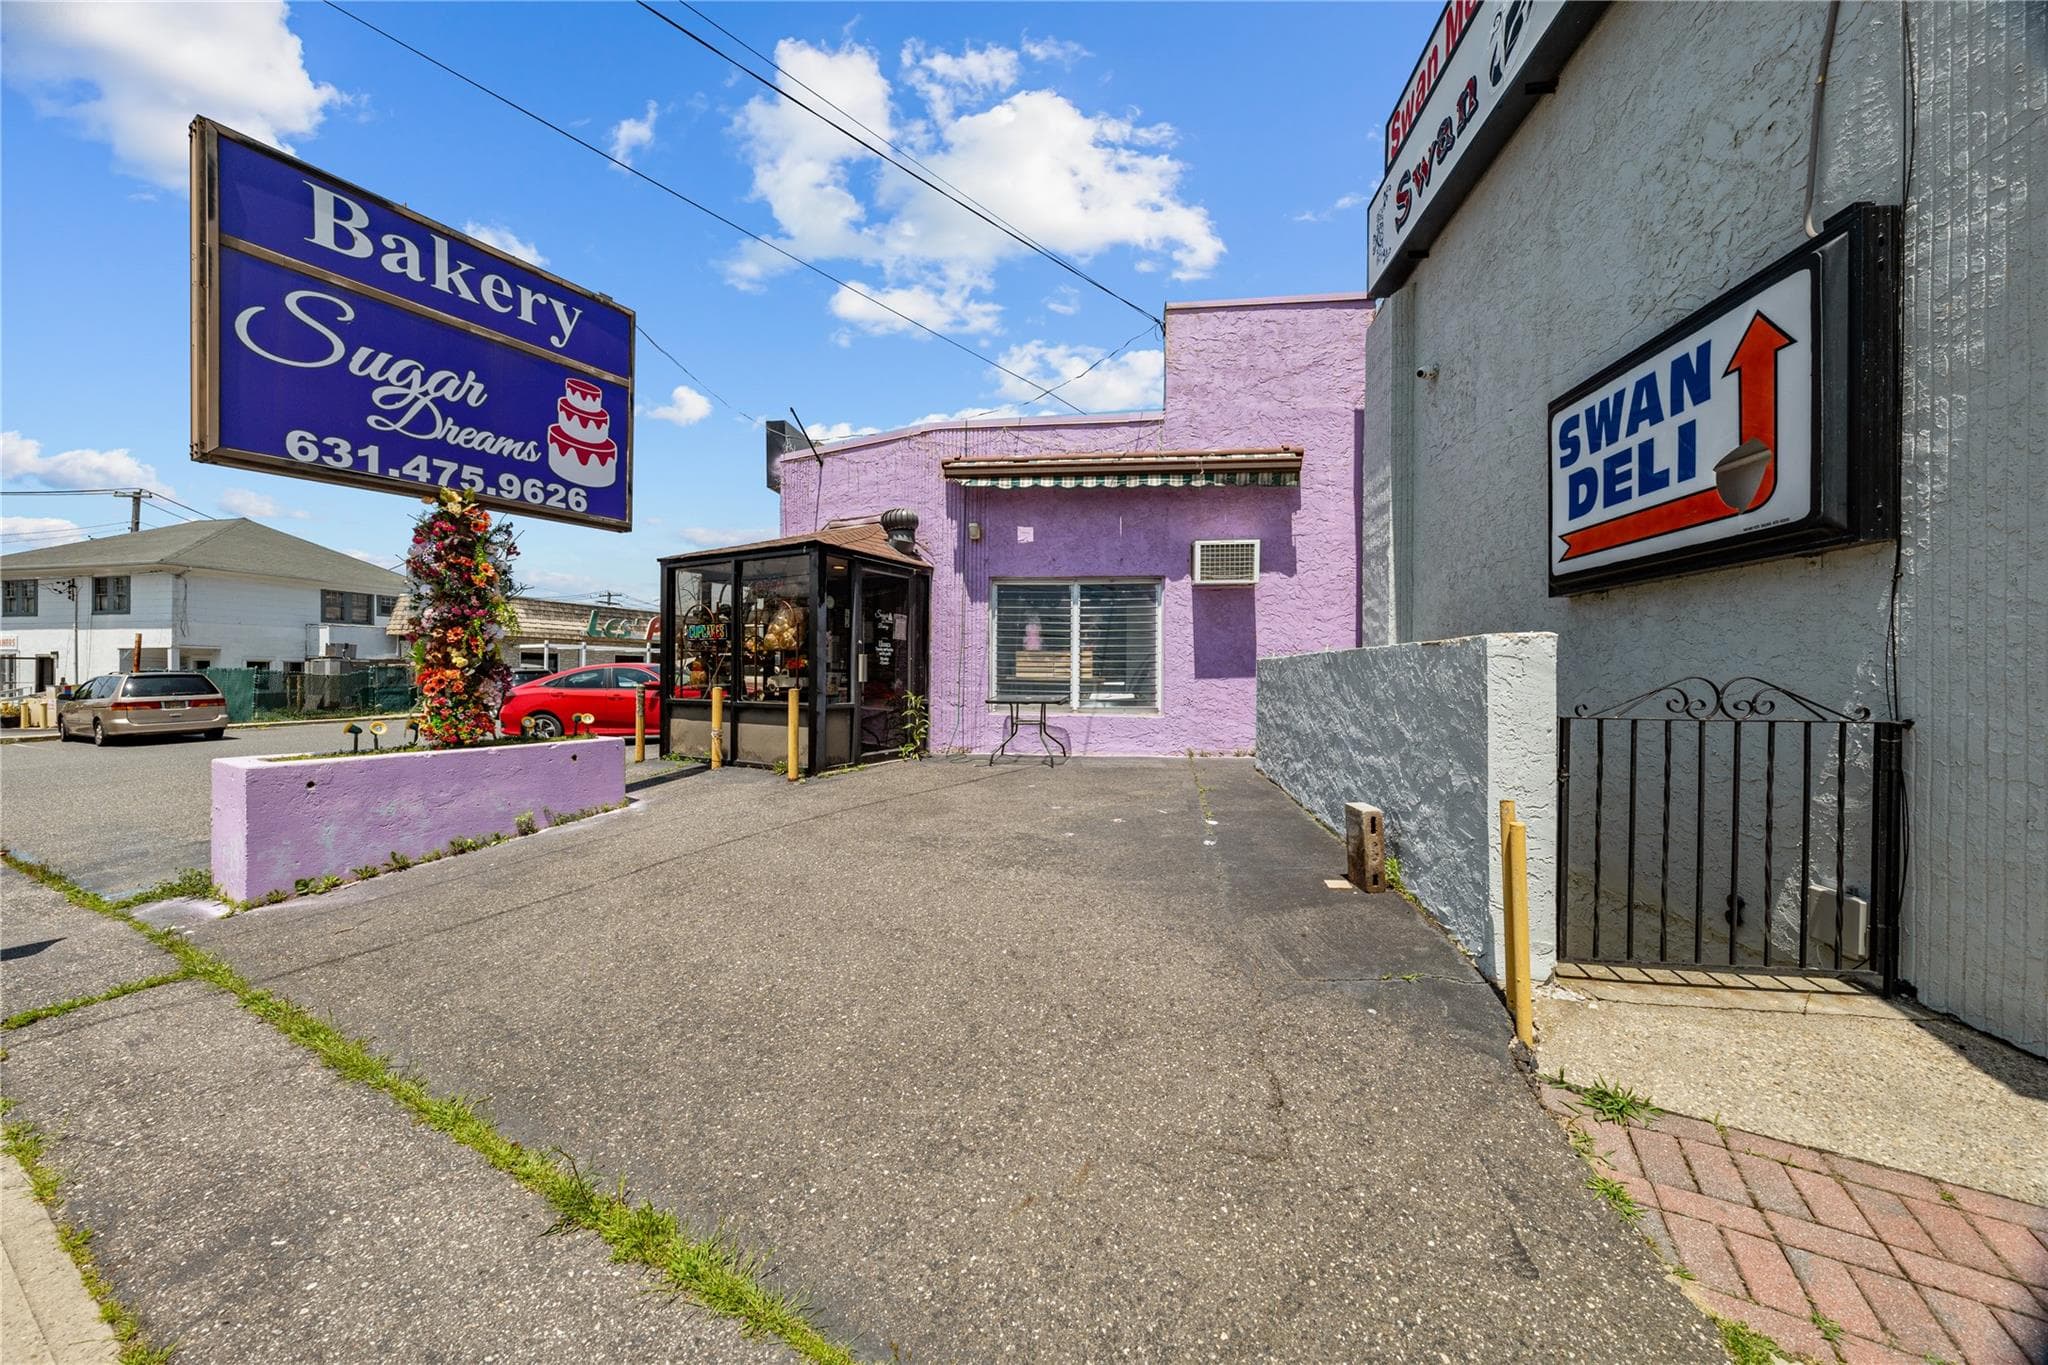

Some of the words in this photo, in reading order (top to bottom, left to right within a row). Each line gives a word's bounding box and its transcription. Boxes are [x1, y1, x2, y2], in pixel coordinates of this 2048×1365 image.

[1391, 44, 1438, 159] Swan
[1395, 75, 1479, 234] Swan
[303, 180, 582, 349] Bakery
[234, 290, 488, 411] Sugar
[1559, 339, 1712, 469] SWAN
[285, 430, 588, 513] 631.475.9626
[366, 399, 542, 463] Dreams
[1568, 419, 1697, 521] DELI
